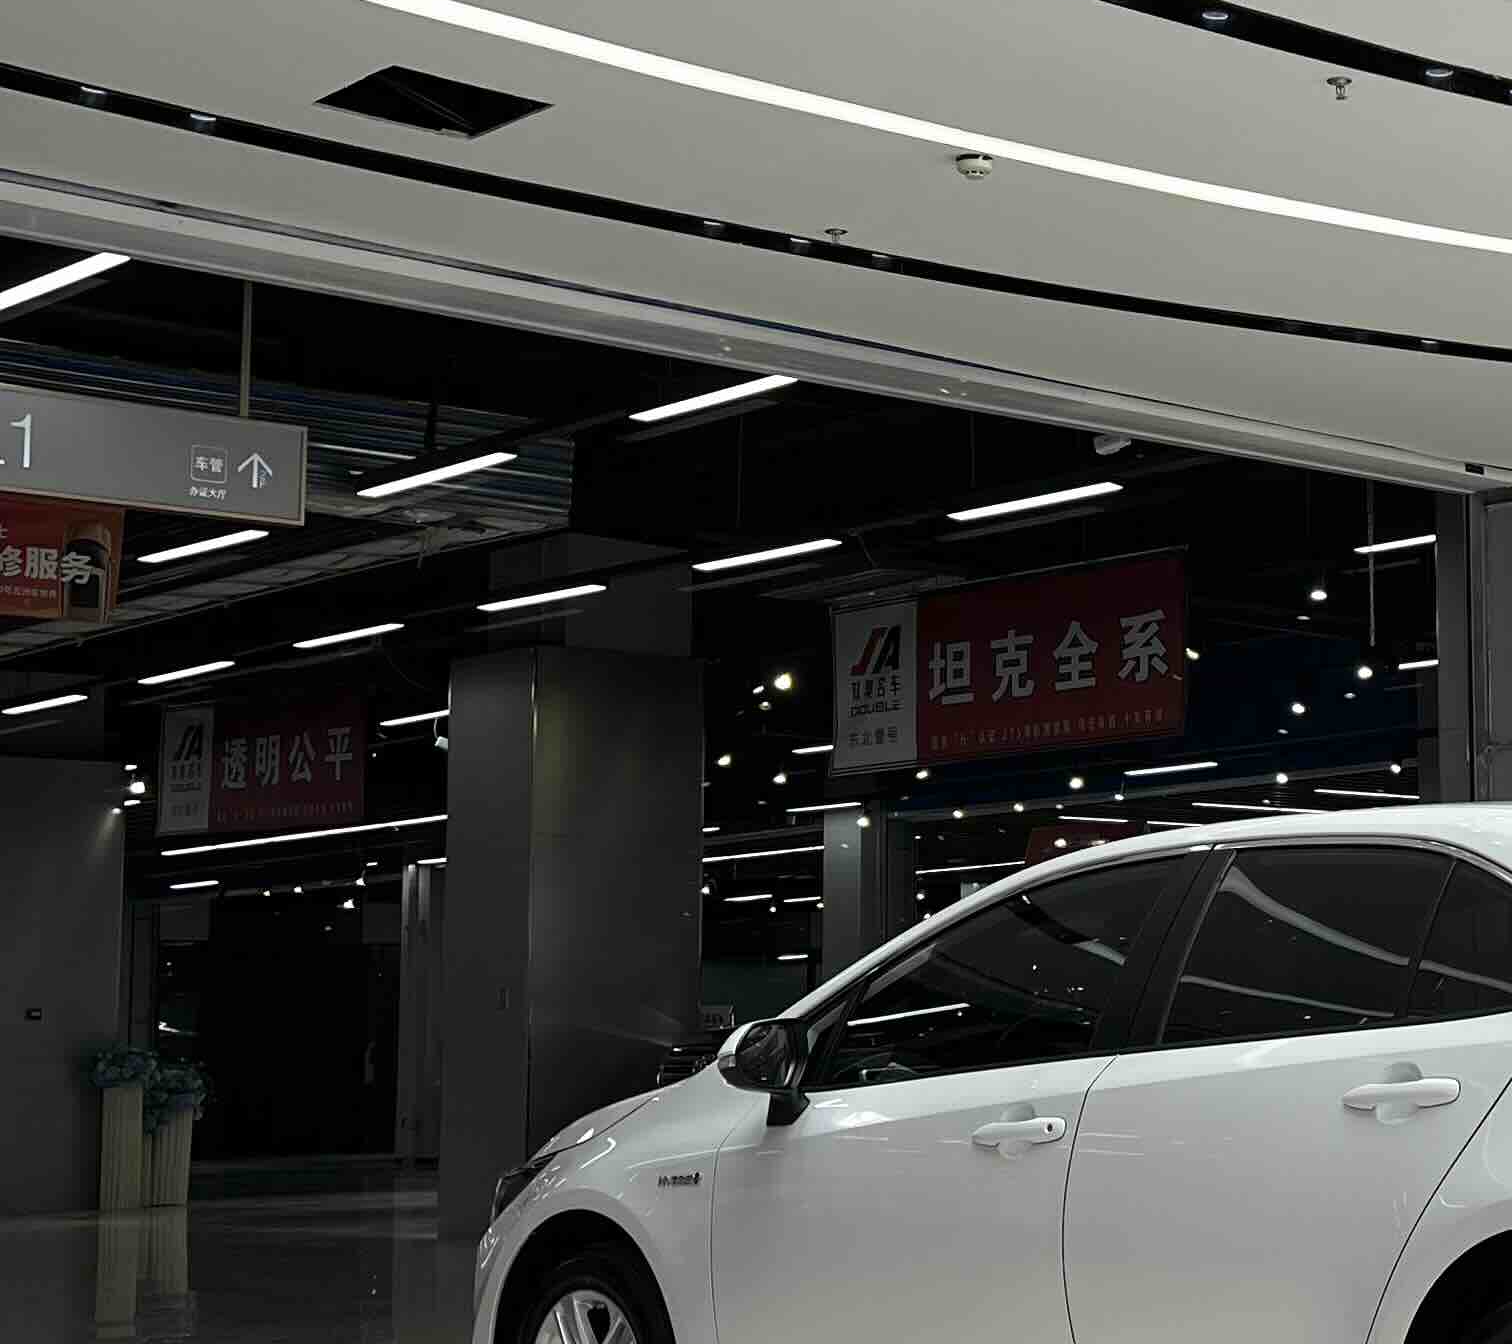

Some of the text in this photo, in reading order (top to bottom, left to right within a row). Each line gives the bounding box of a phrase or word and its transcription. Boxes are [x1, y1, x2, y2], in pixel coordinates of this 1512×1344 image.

[928, 608, 1170, 705] 坦克全系
[220, 725, 354, 792] 透明公平
